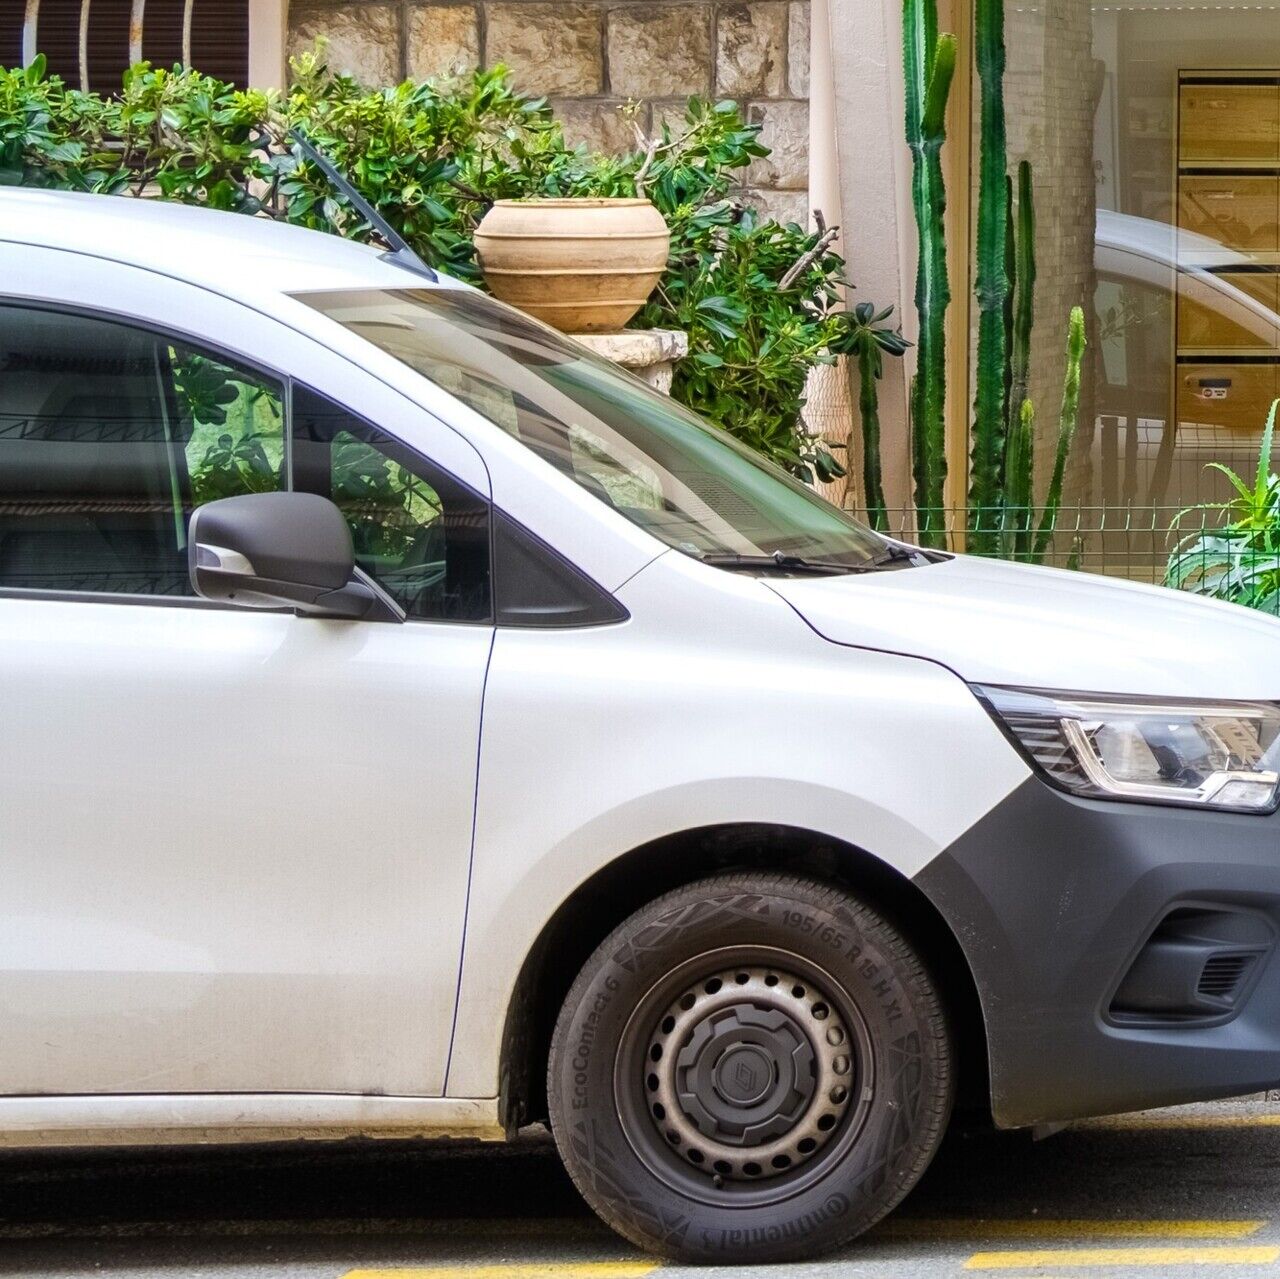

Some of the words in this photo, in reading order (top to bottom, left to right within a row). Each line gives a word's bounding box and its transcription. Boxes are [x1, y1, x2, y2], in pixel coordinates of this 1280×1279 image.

[782, 910, 847, 950] 195/65
[845, 945, 862, 963] R
[860, 958, 879, 979] 15
[871, 979, 892, 998] H
[571, 992, 612, 1110] EcoContact
[605, 975, 620, 991] 6
